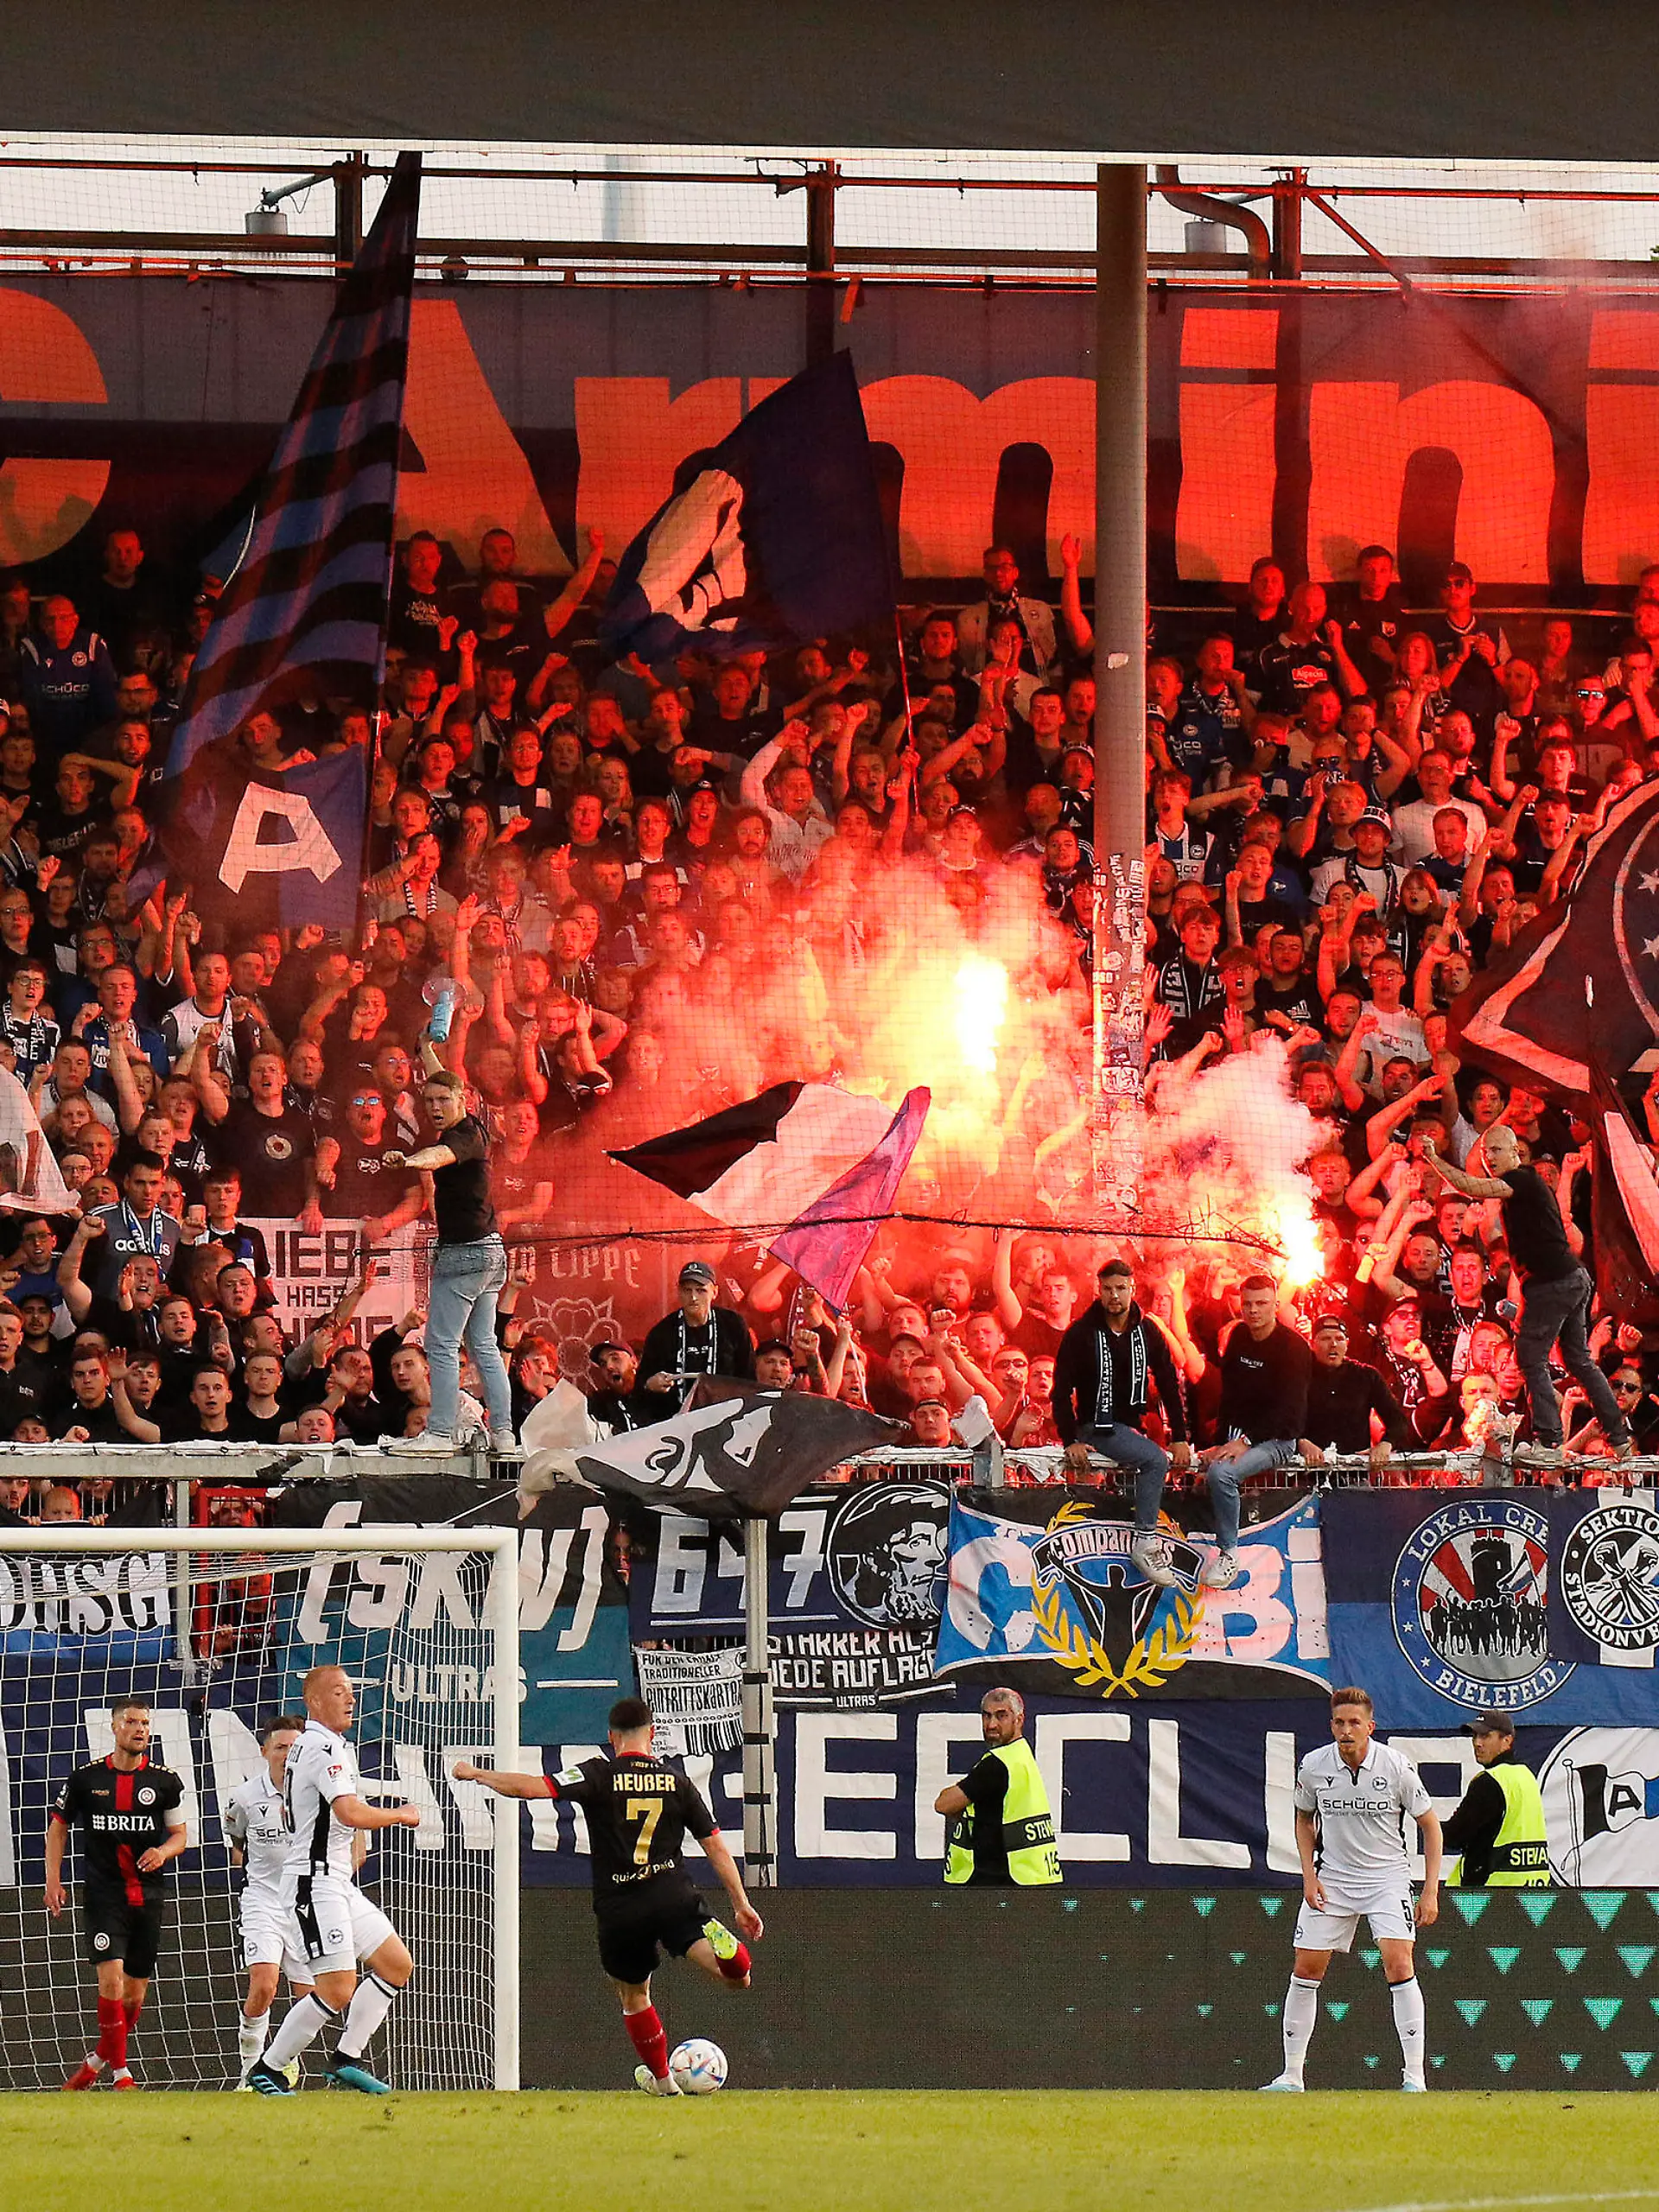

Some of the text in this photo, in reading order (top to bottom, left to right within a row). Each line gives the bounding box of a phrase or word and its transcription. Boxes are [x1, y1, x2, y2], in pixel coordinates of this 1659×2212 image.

[1408, 1505, 1492, 1561] LOKAL
[836, 1694, 877, 1708] ULTRAS
[1434, 1667, 1557, 1708] BIELEFELD
[1322, 1797, 1389, 1811] SCHÜCO
[1607, 1784, 1643, 1817] A
[107, 1815, 156, 1832] BRITA
[626, 1797, 664, 1865] 7
